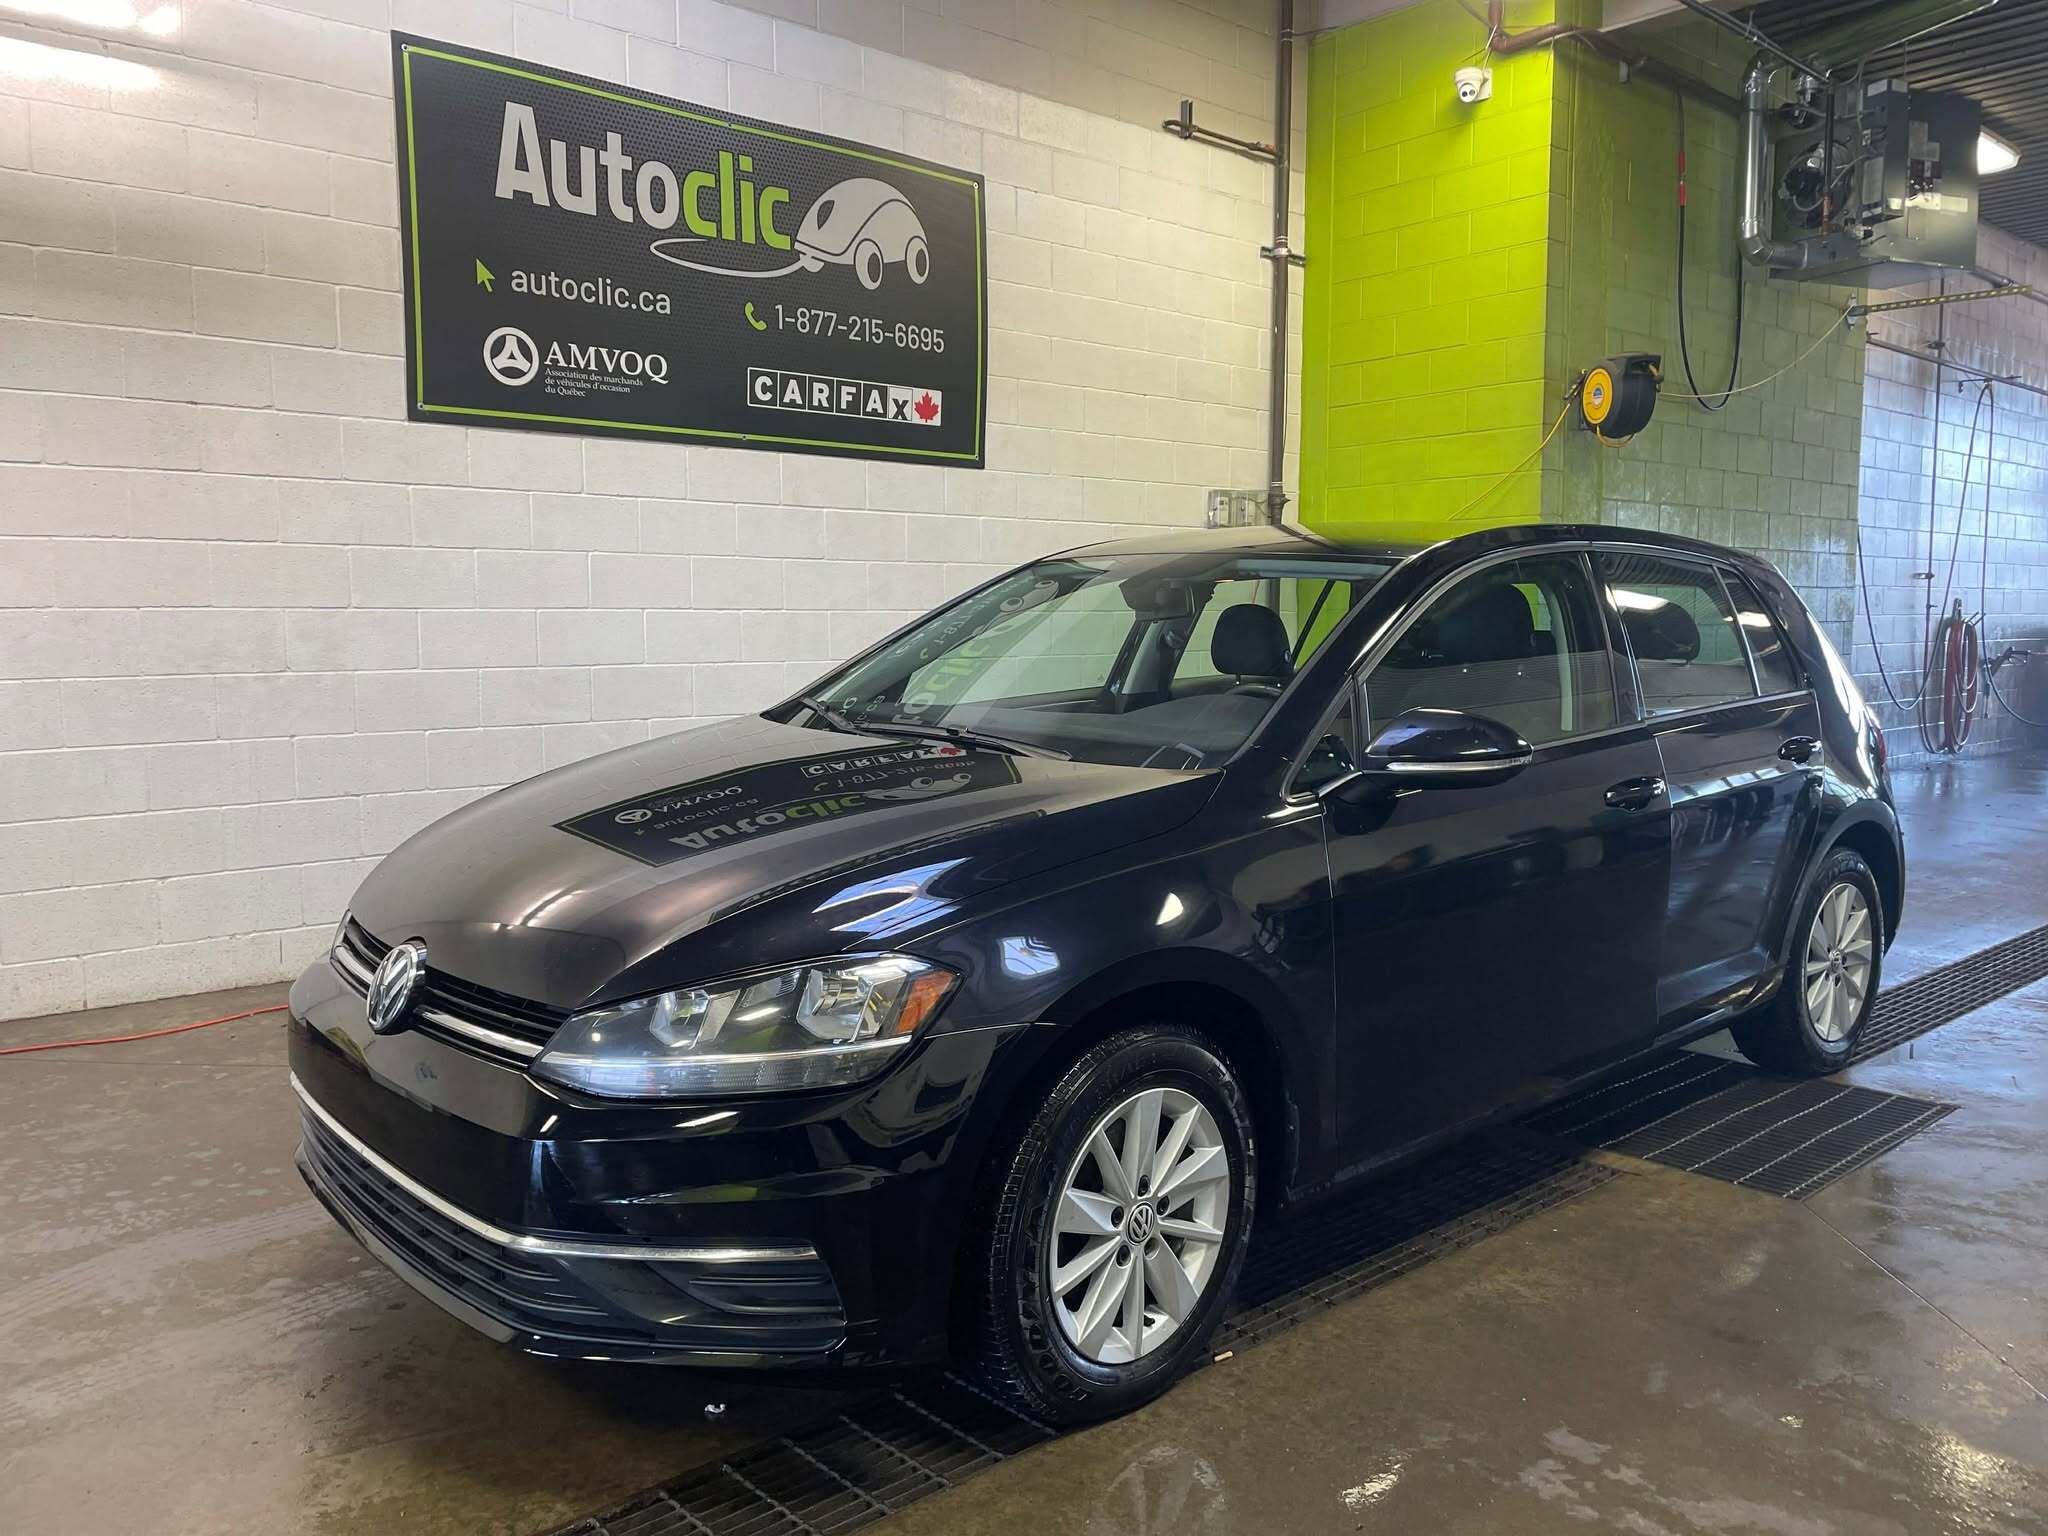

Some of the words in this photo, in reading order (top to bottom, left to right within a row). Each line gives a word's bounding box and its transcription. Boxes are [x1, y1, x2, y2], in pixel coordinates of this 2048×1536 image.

[495, 101, 791, 250] Autoclic
[511, 270, 672, 315] autoclic.ca
[775, 304, 945, 353] 1-877-215-6695
[544, 341, 669, 384] AMVOQ
[545, 367, 588, 380] Association
[590, 373, 602, 381] des
[603, 376, 644, 386] marchands
[545, 376, 555, 385] de
[592, 382, 631, 393] d'occasion
[545, 385, 556, 393] du
[557, 386, 586, 397] Québec
[754, 375, 909, 420] CARFAX
